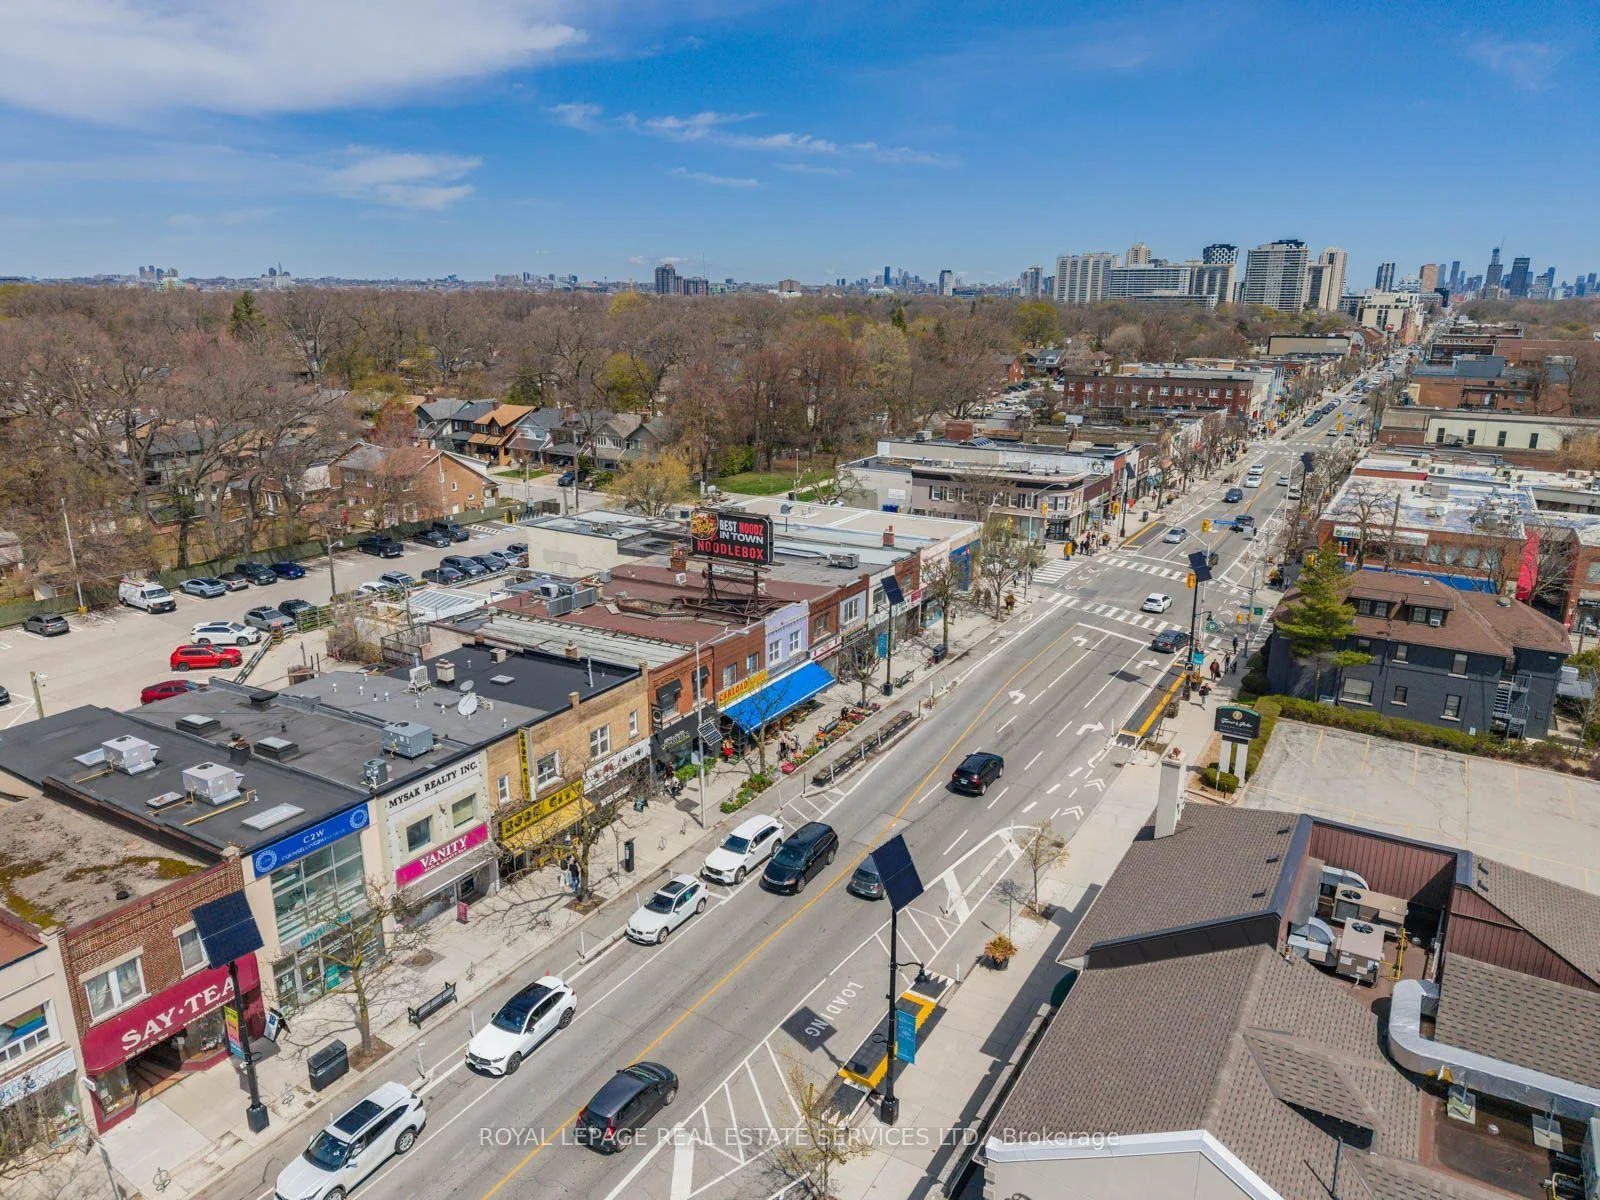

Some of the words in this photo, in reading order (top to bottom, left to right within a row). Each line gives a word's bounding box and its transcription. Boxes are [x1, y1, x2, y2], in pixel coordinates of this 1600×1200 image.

[719, 519, 738, 533] BEST
[739, 522, 763, 536] NOODZ
[719, 531, 730, 540] IN
[730, 532, 764, 545] TOWN
[697, 540, 764, 560] NOODLEBOX
[388, 787, 421, 809] MYSAK
[424, 769, 457, 793] REALTY
[460, 760, 478, 776] INC.
[303, 828, 325, 844] C2W
[420, 835, 467, 869] VANITY
[121, 1006, 176, 1051] SAY
[184, 976, 236, 1014] TEA
[804, 981, 864, 1038] LOADING
